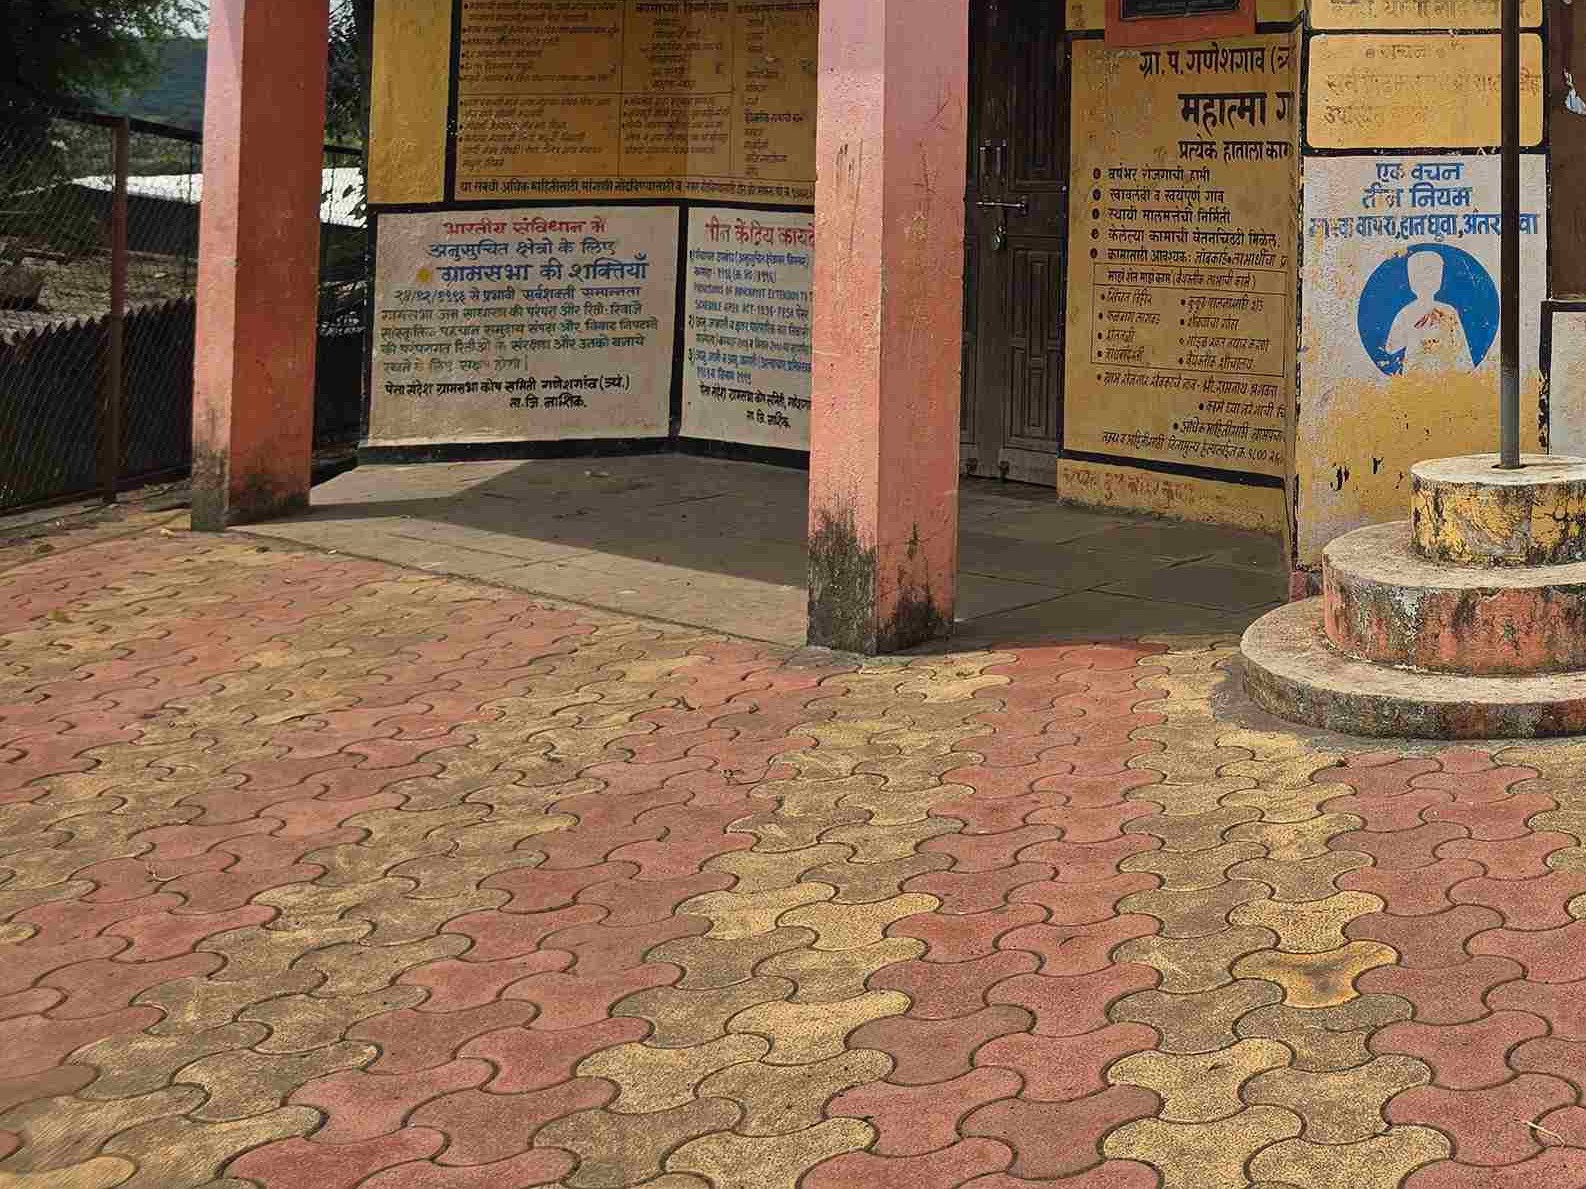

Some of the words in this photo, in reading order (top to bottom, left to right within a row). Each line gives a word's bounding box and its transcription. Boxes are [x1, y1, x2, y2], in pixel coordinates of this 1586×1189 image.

[1178, 91, 1268, 136] महात्मा
[436, 264, 534, 288] ग्रामसभा
[540, 256, 563, 281] की
